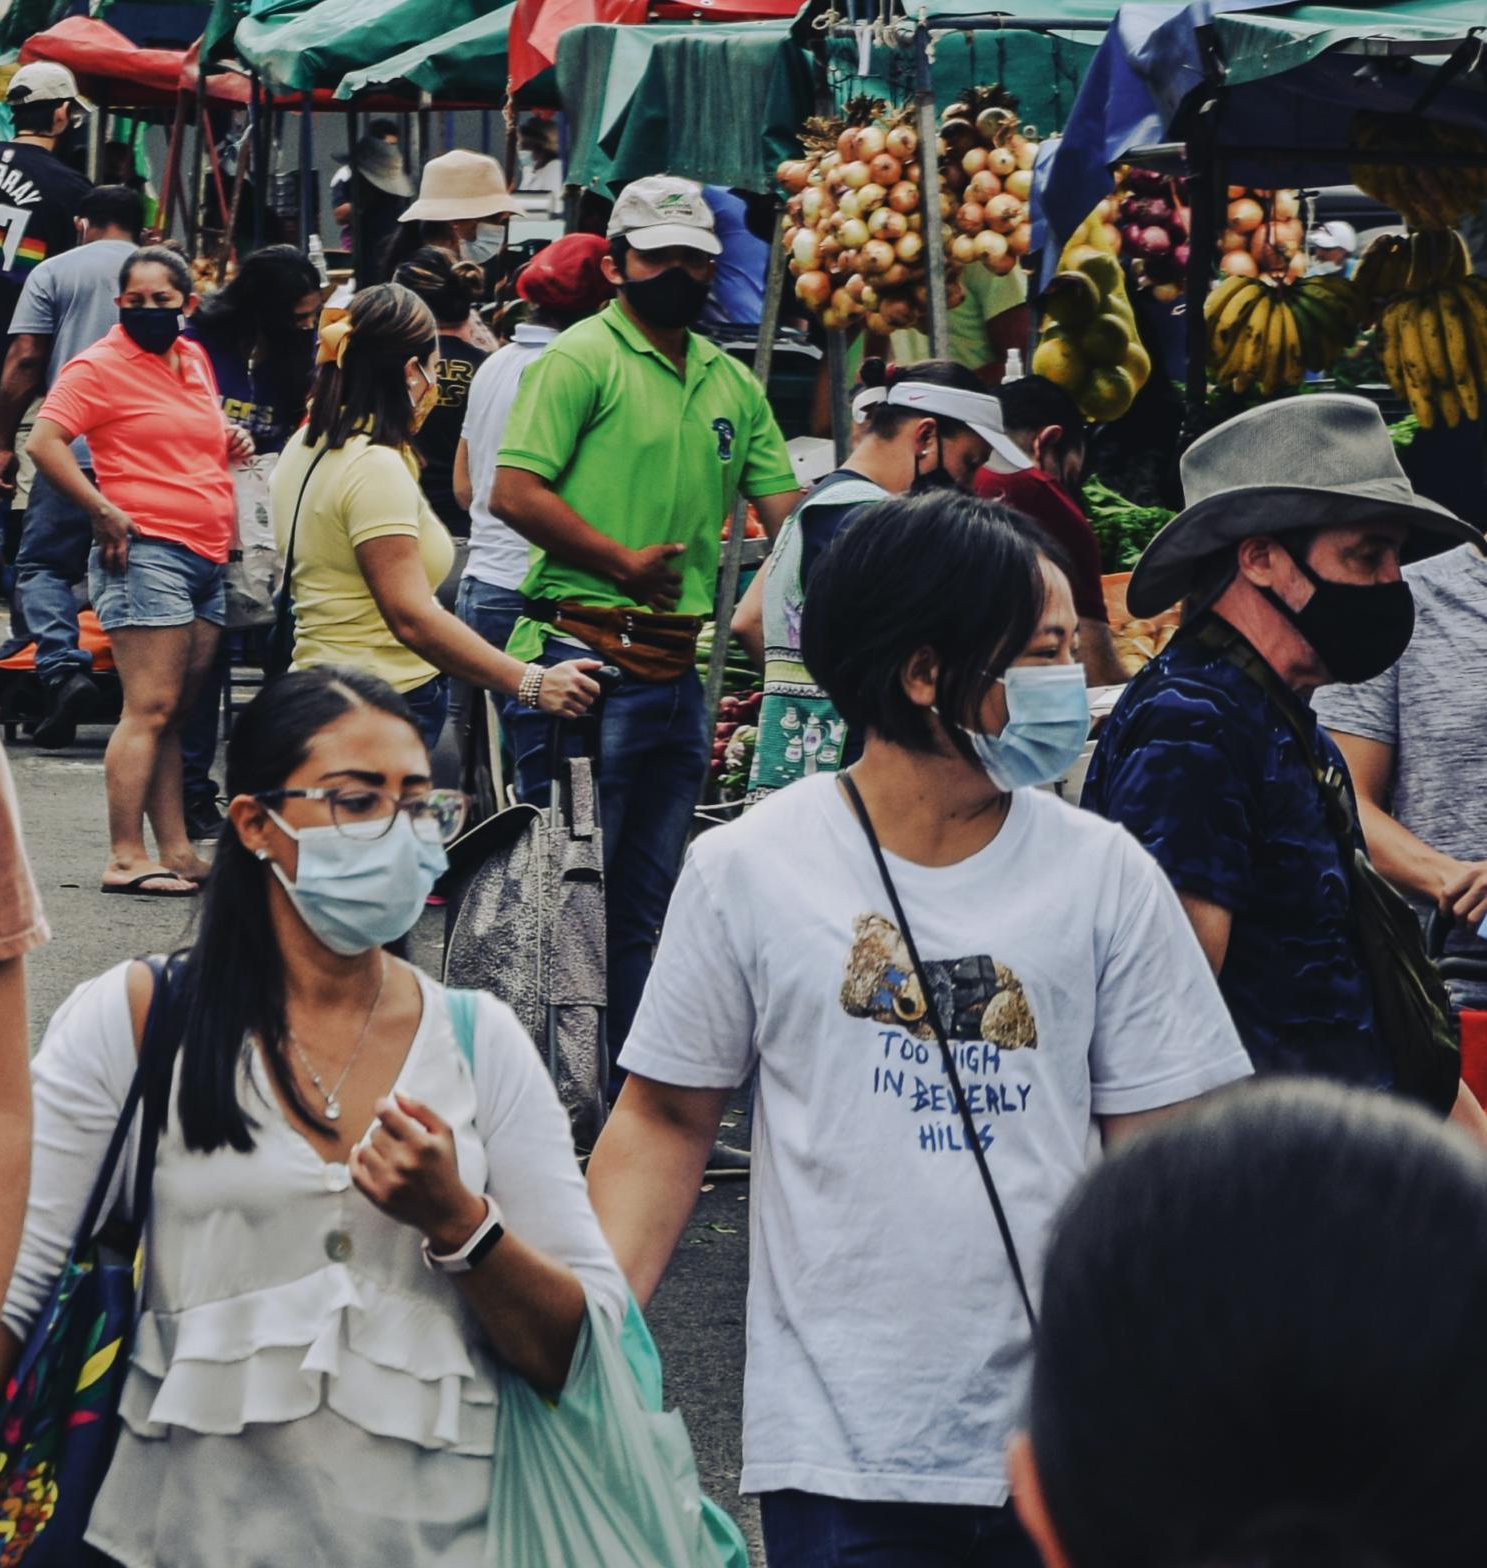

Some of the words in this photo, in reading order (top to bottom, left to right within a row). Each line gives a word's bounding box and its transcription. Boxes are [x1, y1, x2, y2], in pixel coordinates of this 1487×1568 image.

[877, 1030, 929, 1064] TOO
[874, 1066, 905, 1099] IN
[910, 1075, 1032, 1117] BEVERLY
